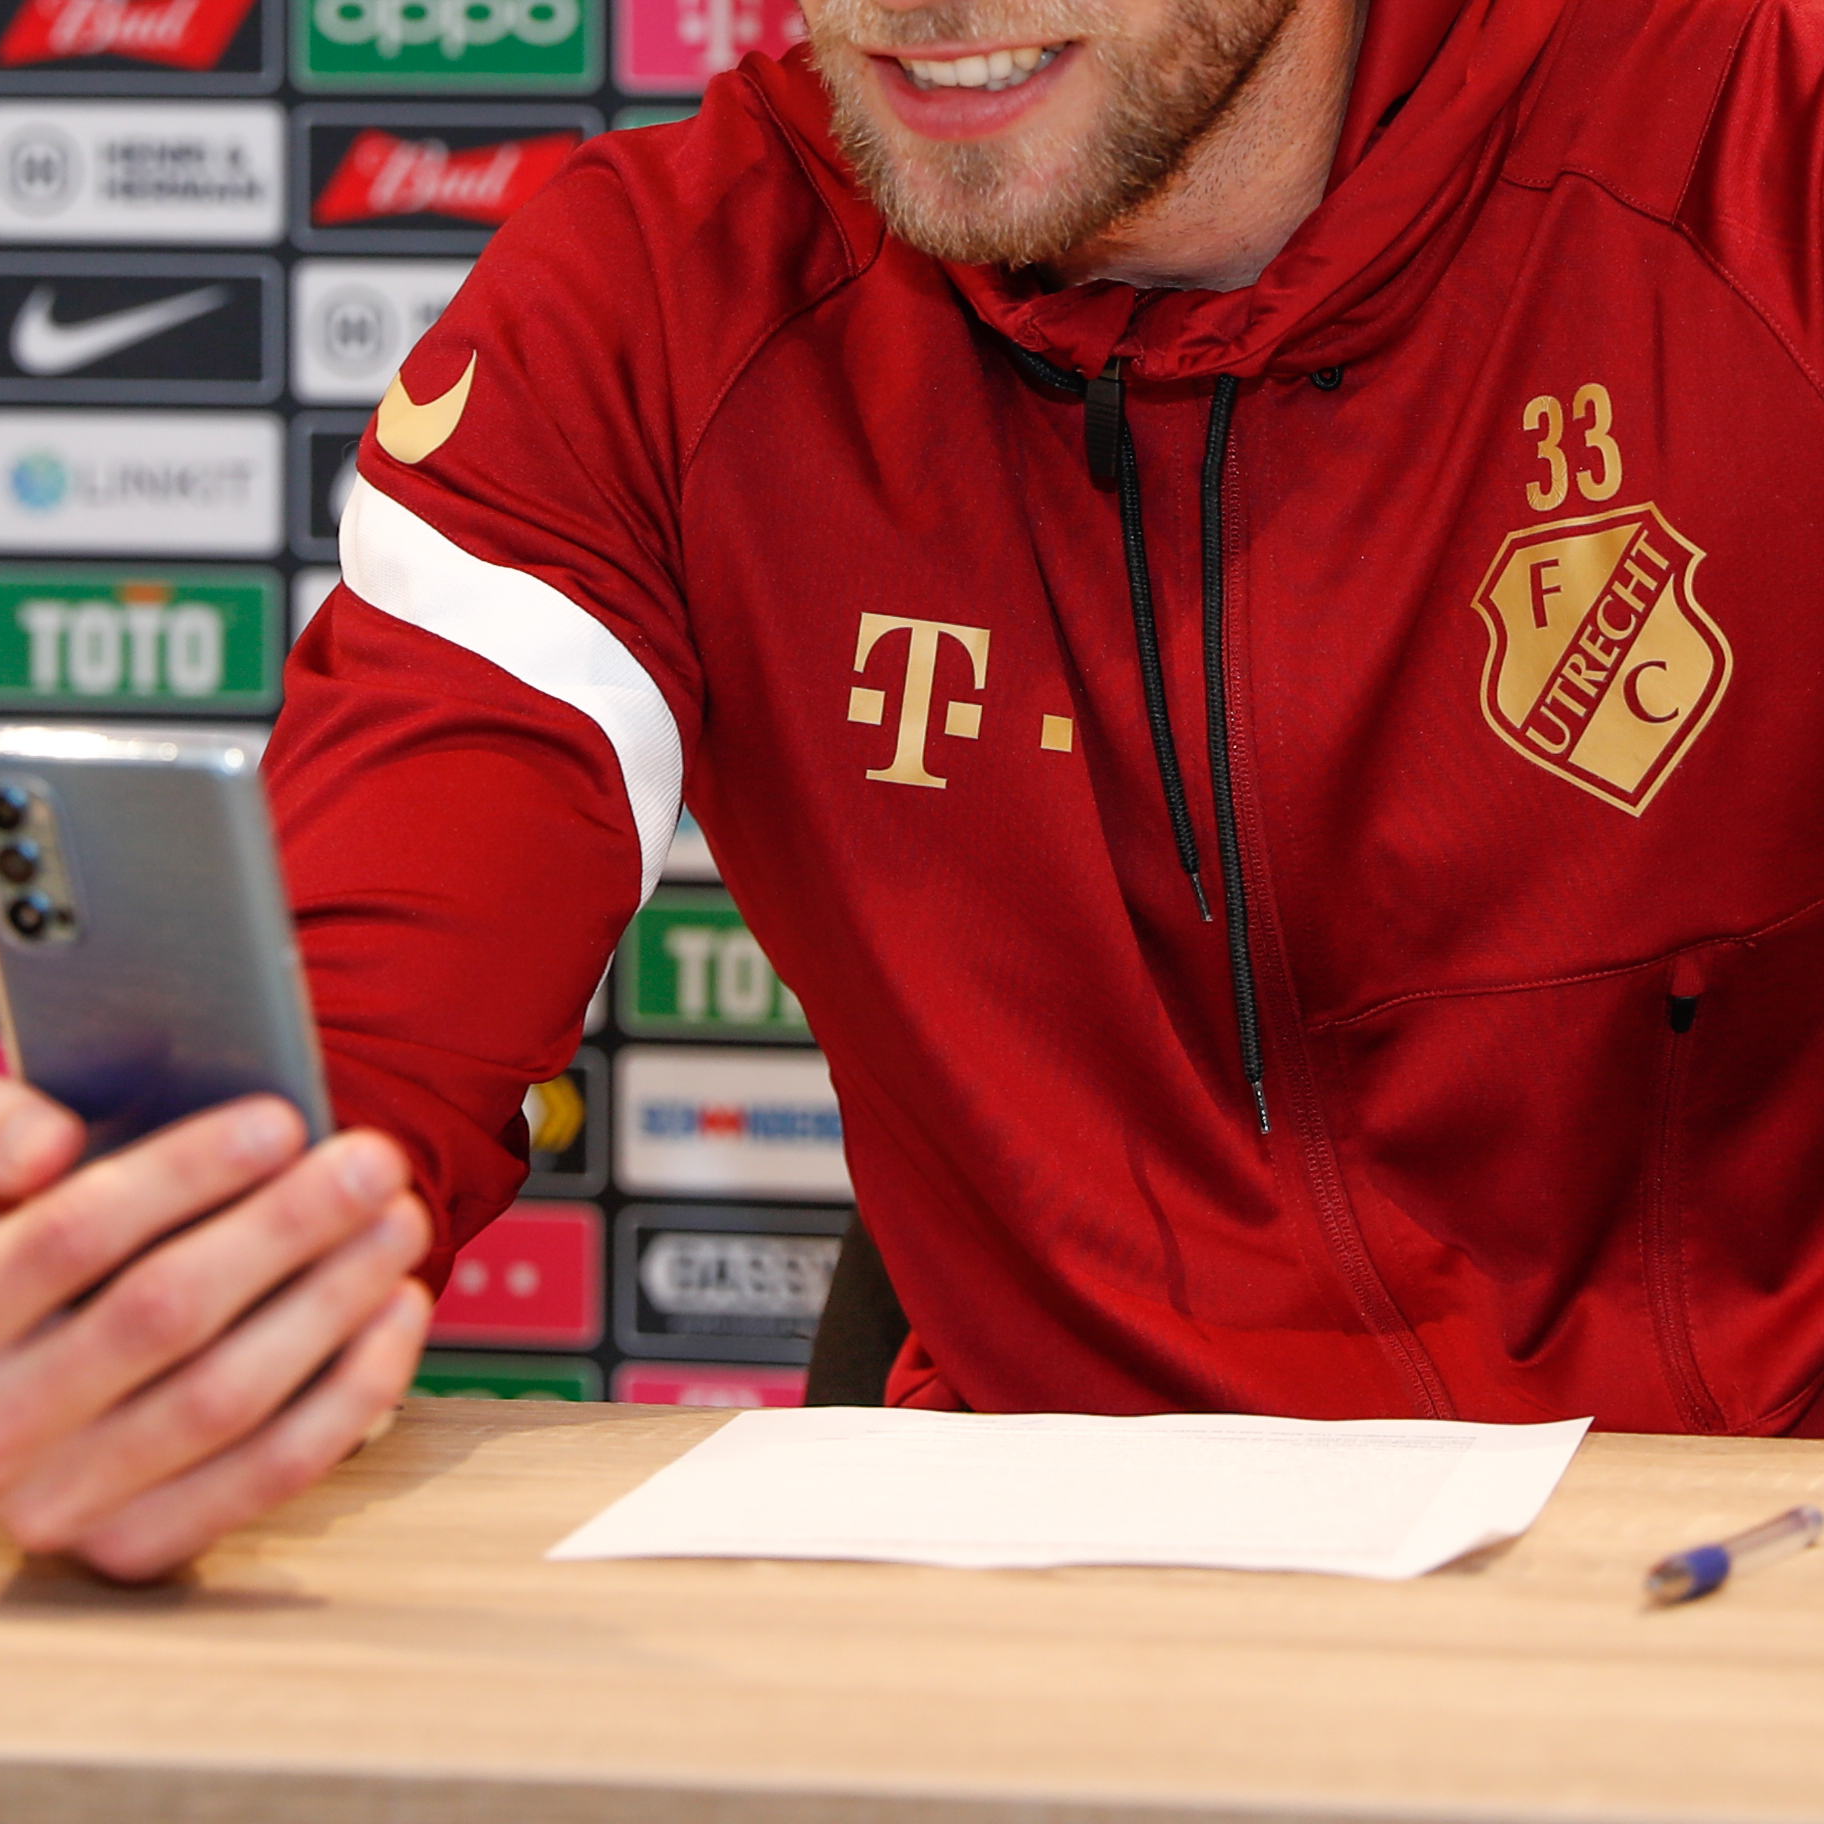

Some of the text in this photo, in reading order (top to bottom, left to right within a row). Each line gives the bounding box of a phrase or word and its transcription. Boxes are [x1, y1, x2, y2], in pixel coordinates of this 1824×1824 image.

[1522, 382, 1623, 512] 33
[1528, 558, 1563, 630] F
[17, 600, 223, 696] TOTO
[1524, 530, 1671, 756] UTRECHT
[1622, 659, 1680, 725] C
